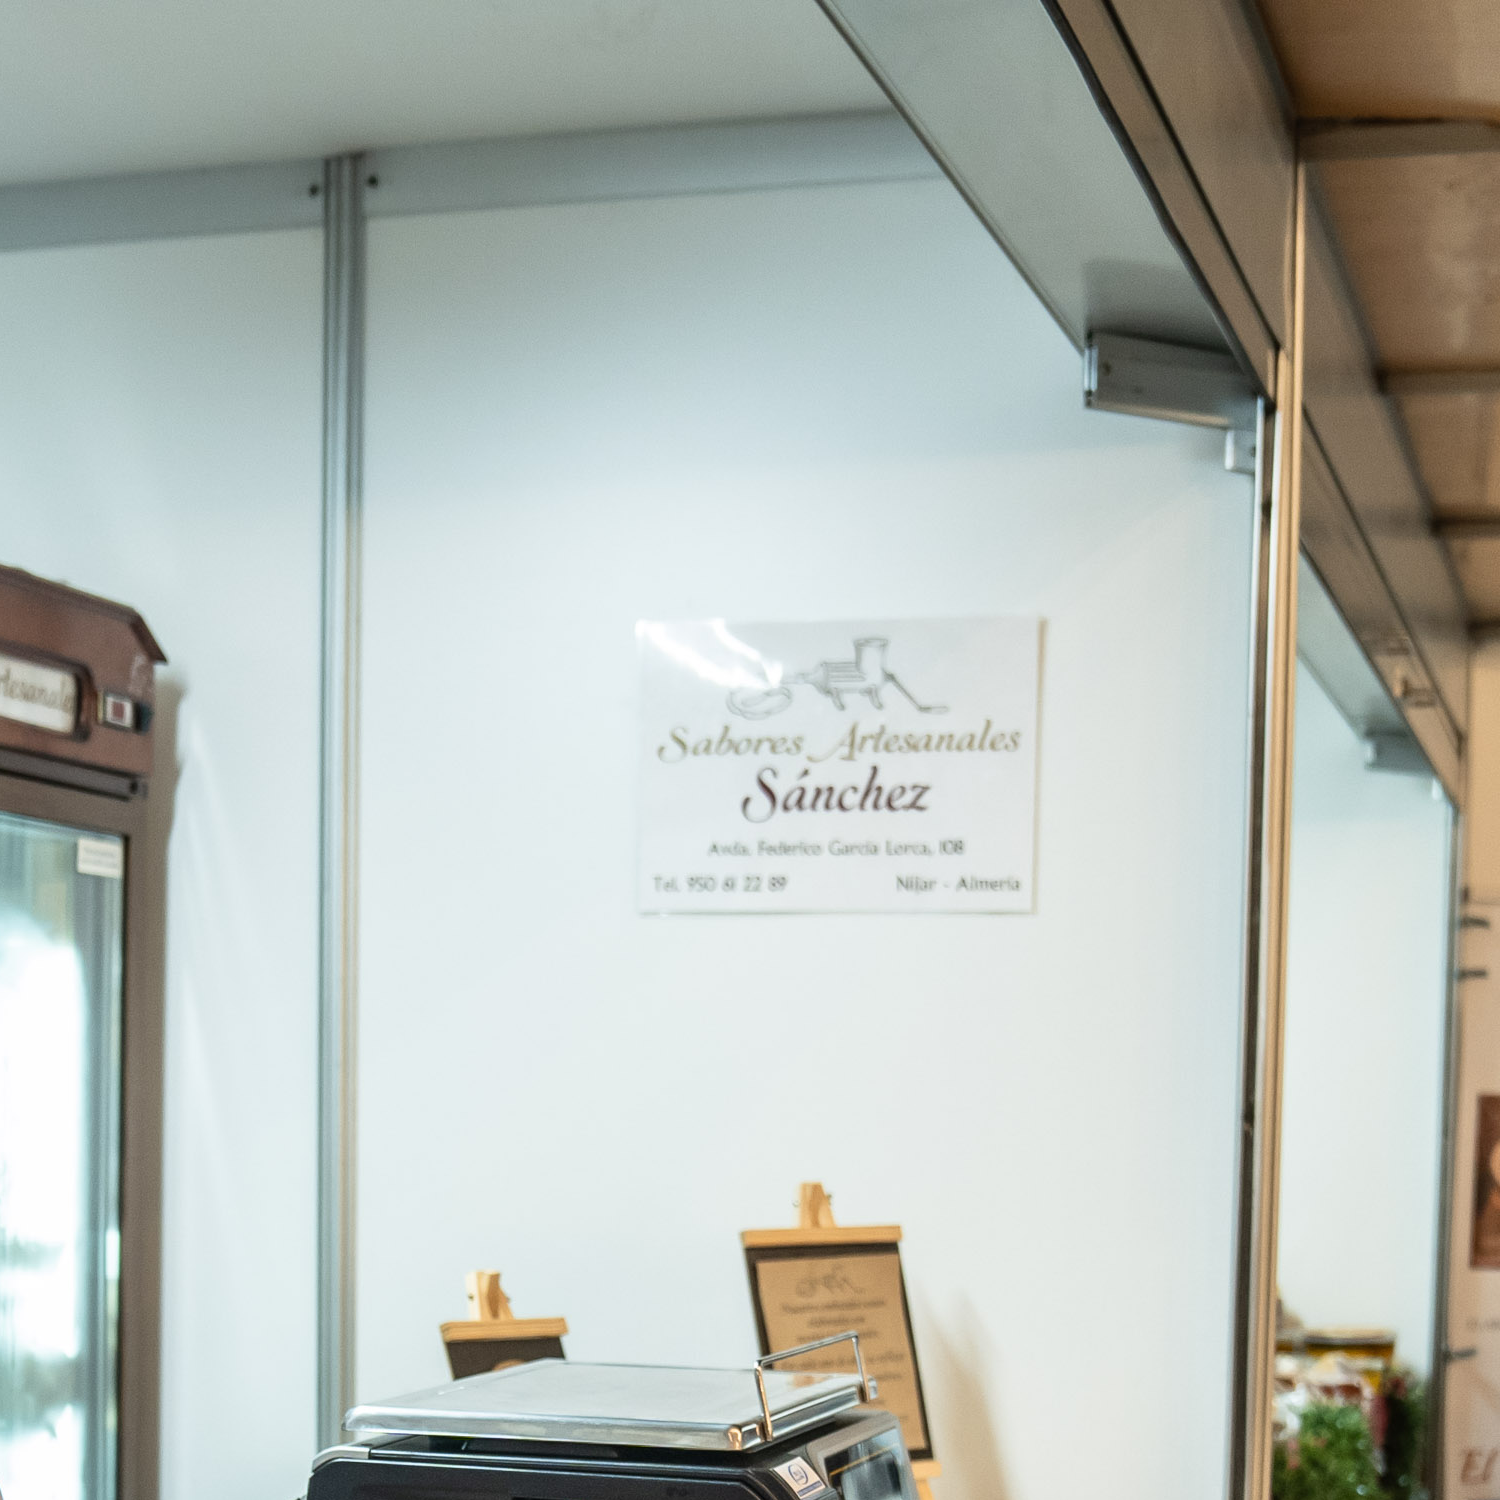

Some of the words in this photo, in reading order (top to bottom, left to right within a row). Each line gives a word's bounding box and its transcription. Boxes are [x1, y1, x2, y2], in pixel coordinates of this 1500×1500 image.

[657, 724, 804, 763] Sabores
[806, 719, 1022, 763] Artesanales
[741, 765, 931, 823] Sánchez
[757, 840, 822, 856] Federico
[687, 875, 716, 892] 950
[743, 875, 762, 892] 22
[768, 875, 787, 892] 89
